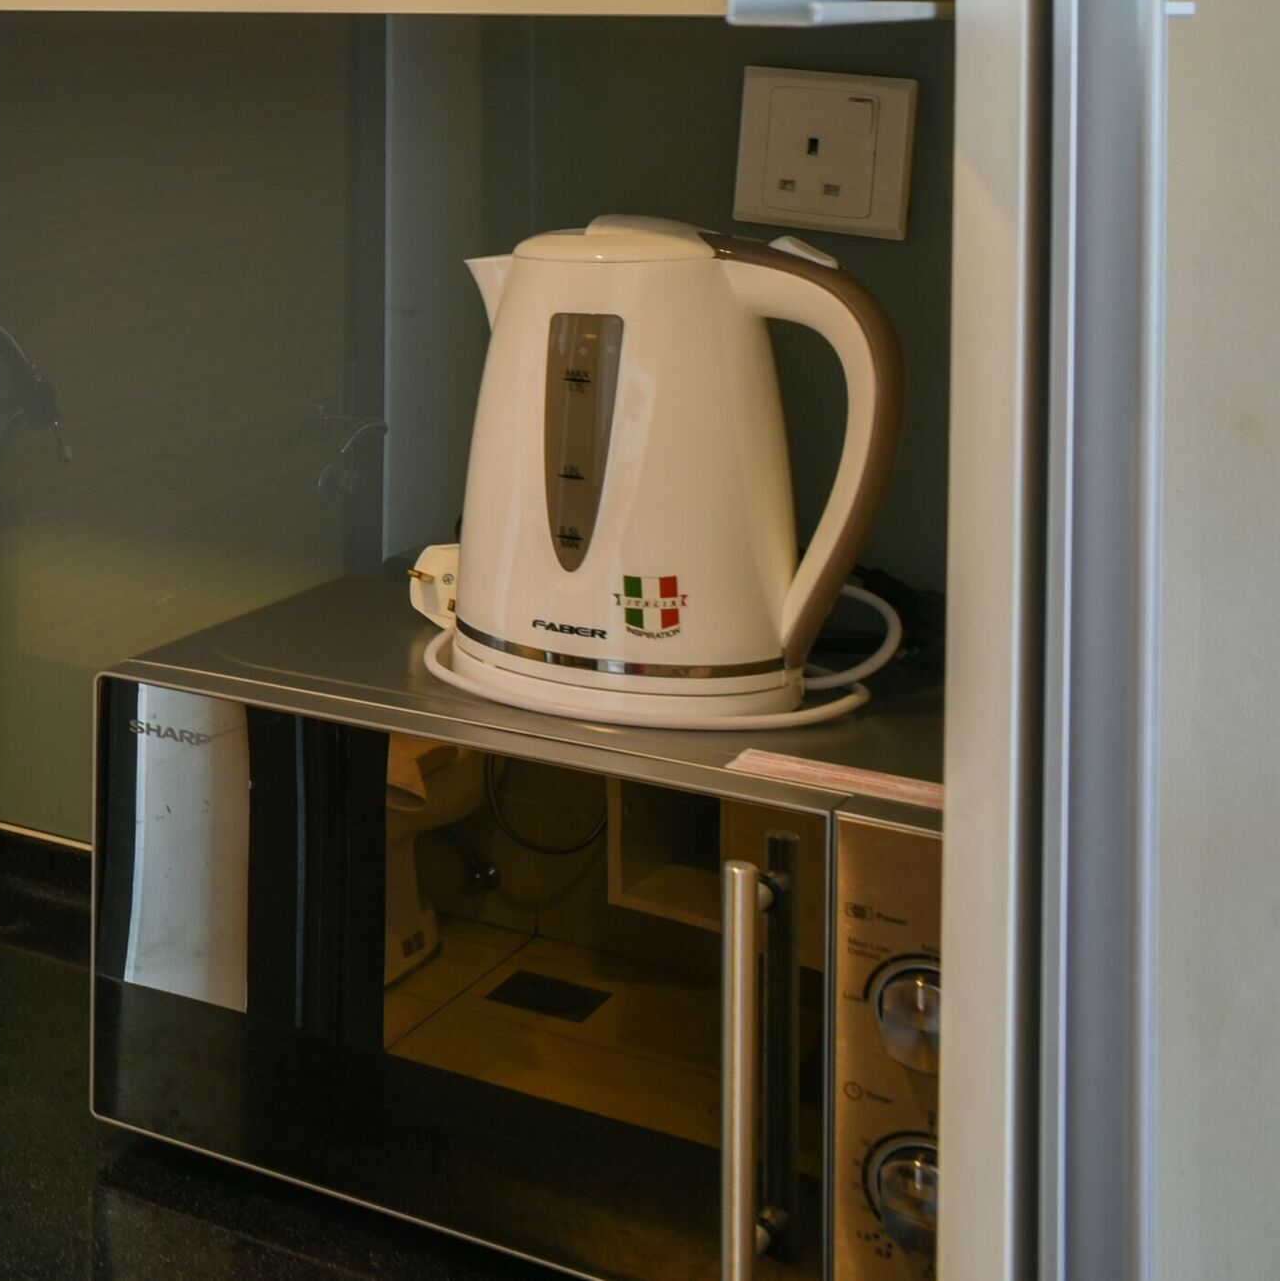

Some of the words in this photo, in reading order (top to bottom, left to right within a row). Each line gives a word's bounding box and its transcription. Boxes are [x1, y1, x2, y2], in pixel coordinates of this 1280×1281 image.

[626, 599, 677, 608] ITALIA
[532, 619, 608, 640] FABER
[625, 625, 681, 640] INSPIRATION
[128, 719, 213, 747] SHARP
